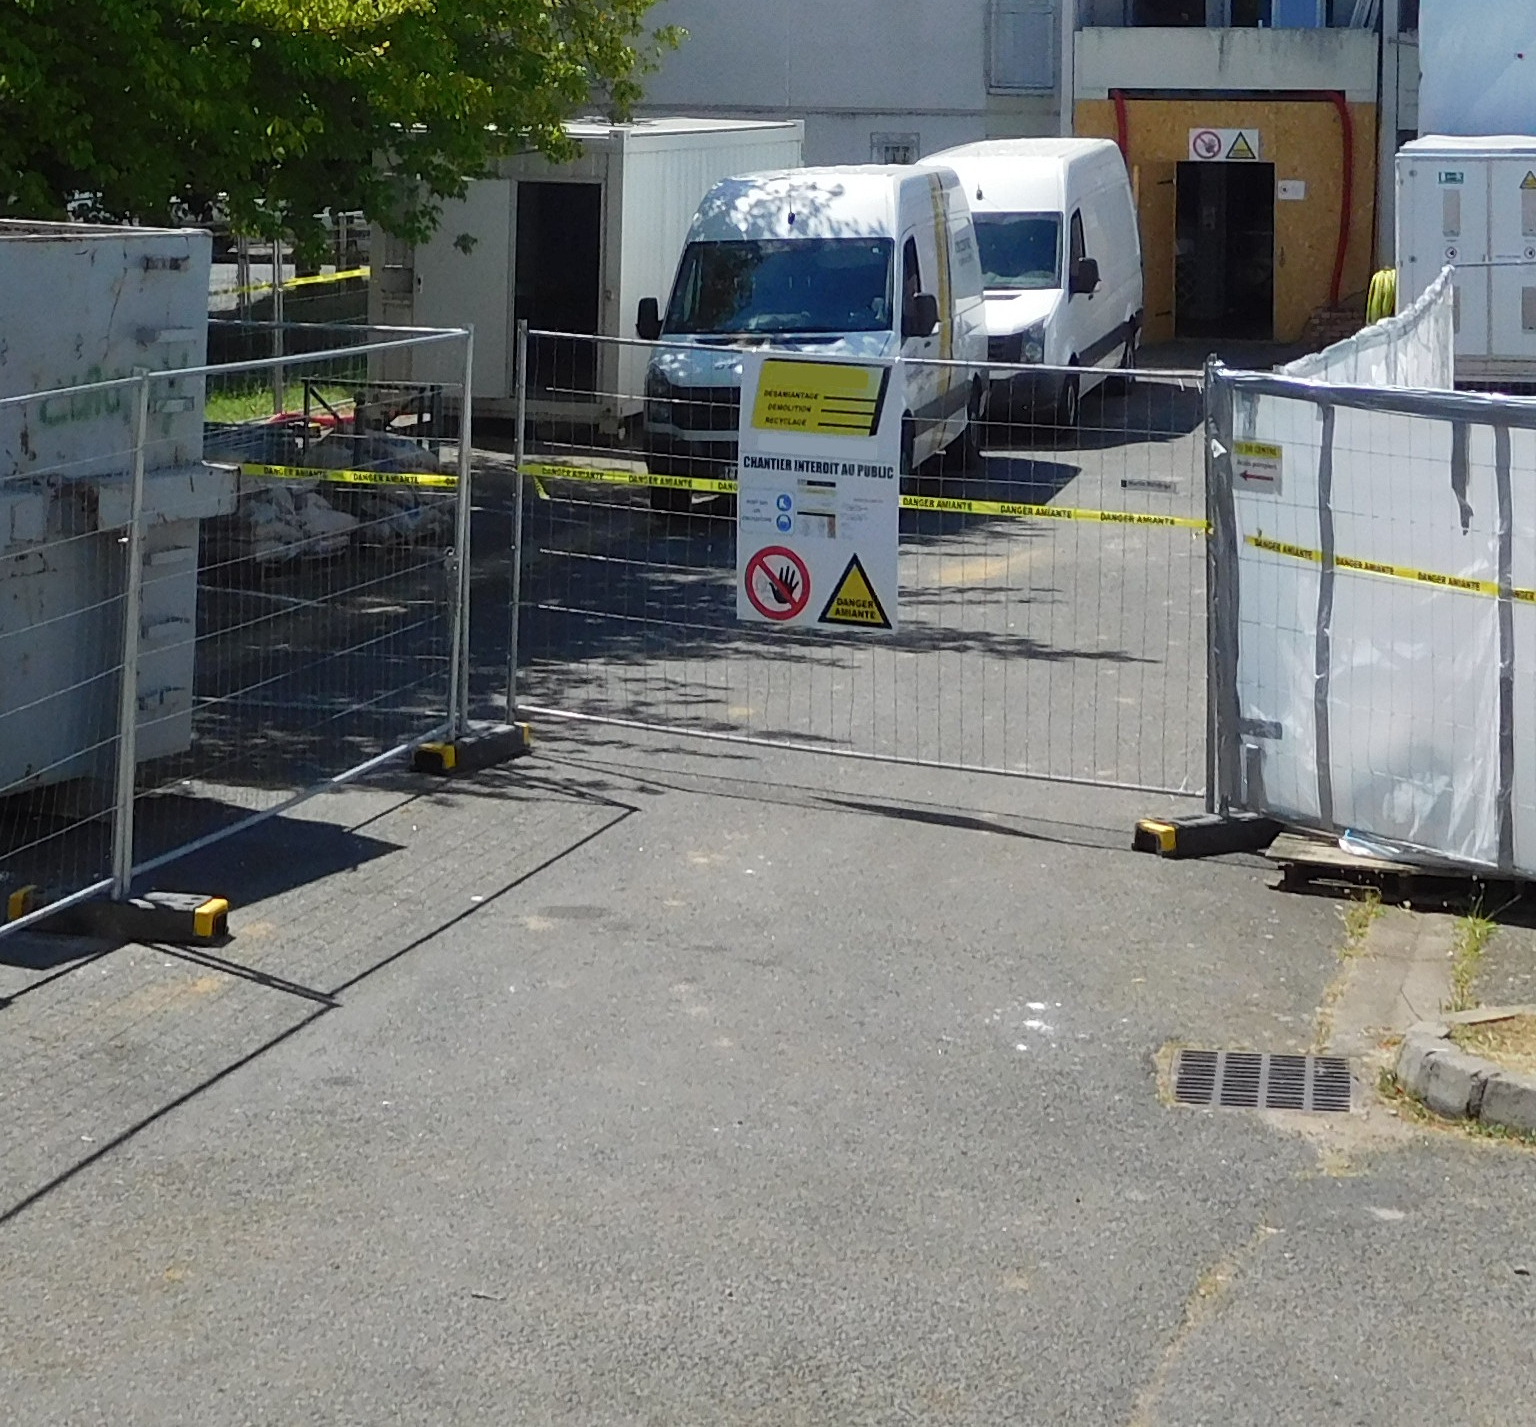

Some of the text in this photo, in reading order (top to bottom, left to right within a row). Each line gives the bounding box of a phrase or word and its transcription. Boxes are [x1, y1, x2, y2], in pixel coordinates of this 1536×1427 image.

[743, 456, 894, 479] CHANTIER INTERDIT AU PUBLIC
[902, 497, 935, 508] DANGER
[1000, 504, 1033, 516] DANGER
[1100, 511, 1134, 523] DANGER
[1417, 571, 1446, 584] DANGER
[836, 597, 874, 608] DANGER
[835, 607, 876, 619] AMIANTE
